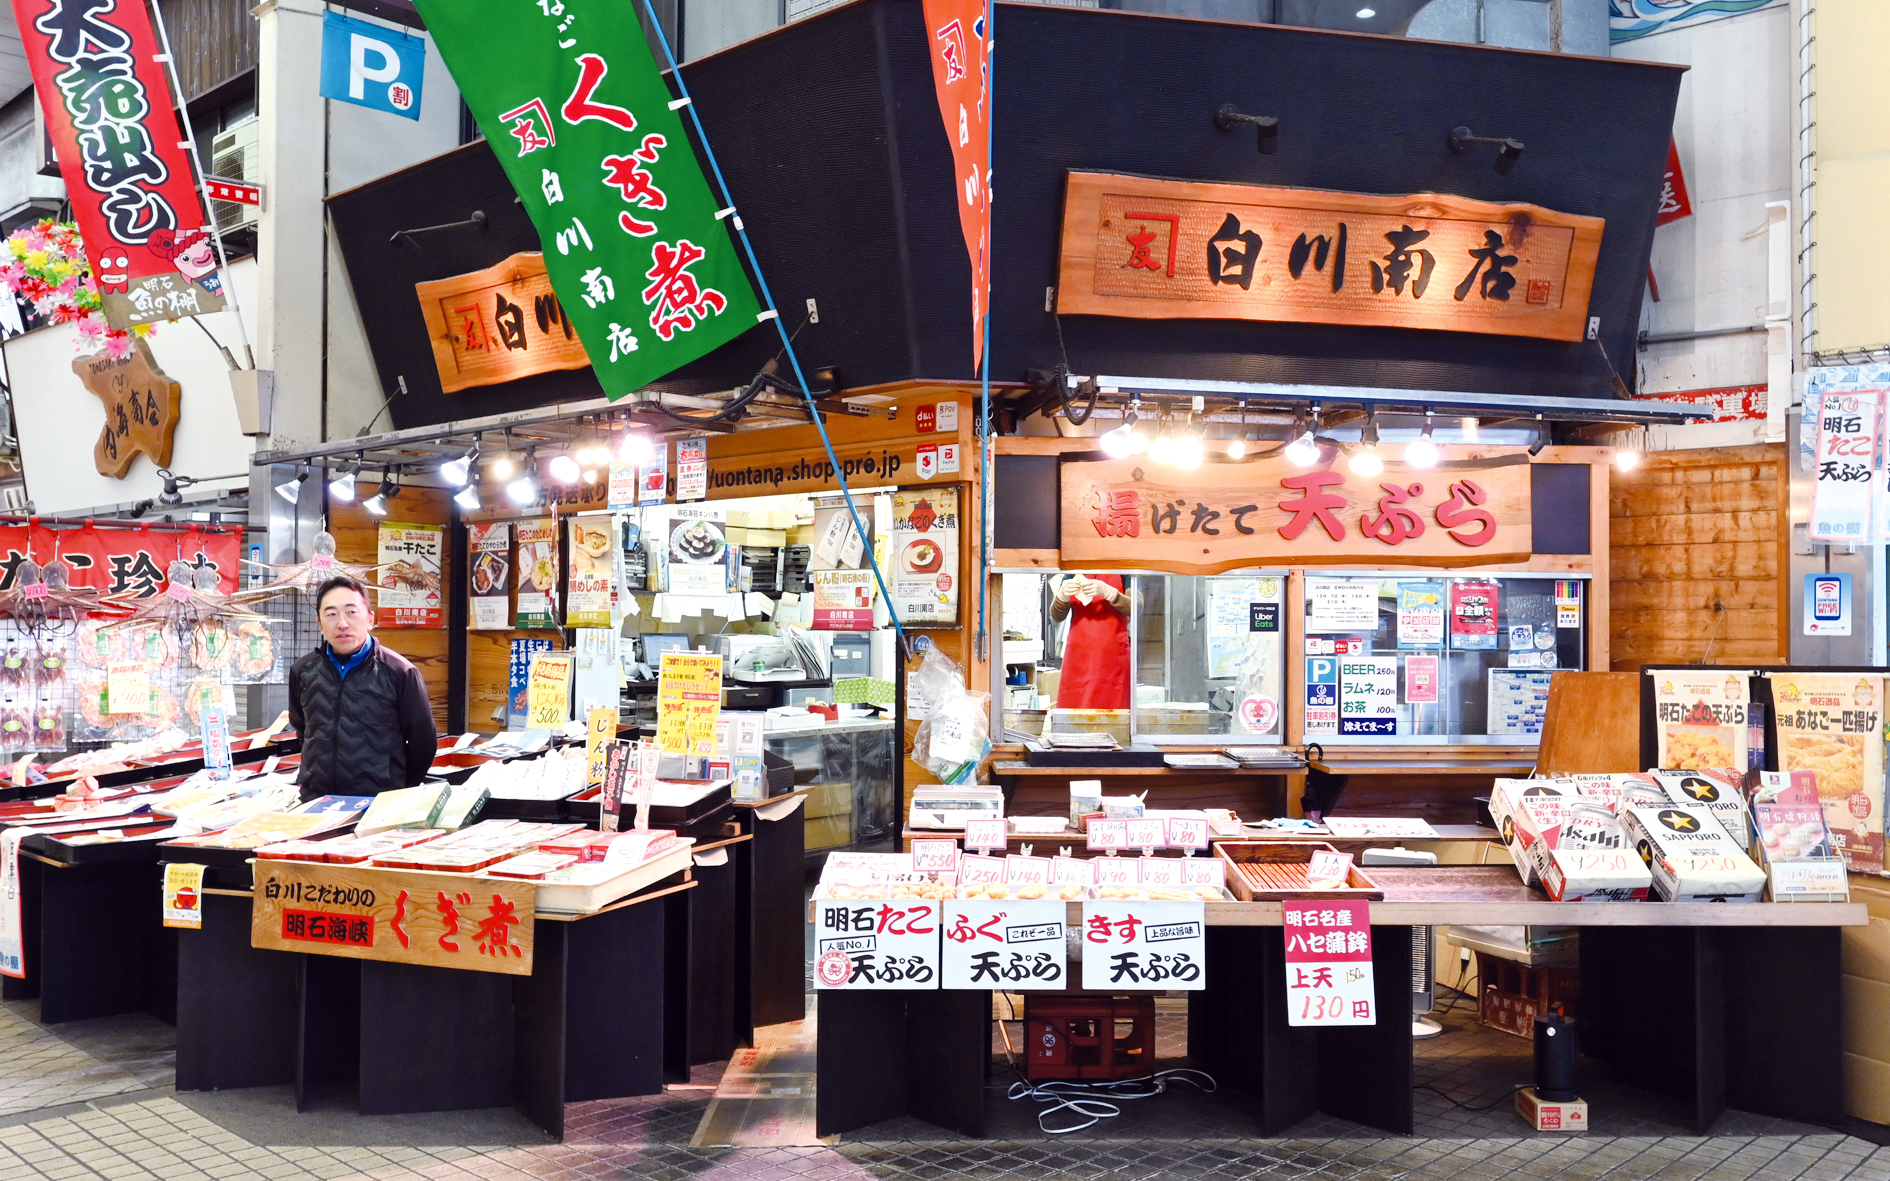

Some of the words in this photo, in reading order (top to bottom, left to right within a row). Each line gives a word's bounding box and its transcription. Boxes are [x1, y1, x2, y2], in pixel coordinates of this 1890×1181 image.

[349, 33, 400, 100] P
[392, 86, 409, 108] 割
[561, 53, 728, 341] くぎ煮
[541, 168, 640, 364] 白川南店
[1206, 213, 1518, 302] 白川南店
[142, 275, 174, 291] 明石
[127, 287, 201, 321] 魚の棚
[1823, 416, 1863, 434] 明石
[1827, 434, 1872, 456] たこ
[1818, 461, 1872, 483] 天ぷら
[1094, 490, 1258, 538] 揚げたて
[1277, 471, 1497, 547] 天ぷら
[403, 542, 437, 555] 干たこ
[569, 579, 609, 593] 鯛めしの素
[815, 572, 840, 585] じん粉
[908, 603, 935, 614] 白川南店
[1254, 612, 1274, 621] Uber
[1255, 620, 1274, 628] Eats
[1312, 659, 1332, 683] P
[1343, 664, 1376, 675] BEER
[1343, 682, 1375, 694] ラムネ
[1309, 697, 1335, 705] 魚の棚
[1343, 700, 1367, 713] お茶
[1306, 711, 1337, 720] 駐車割引券
[1659, 703, 1745, 725] 明石たこの天ぷら
[1777, 714, 1794, 727] 元祖
[1795, 709, 1879, 734] あなご一匹揚げ
[1760, 812, 1821, 822] 明石焼物語
[1560, 825, 1620, 848] Asahi
[1662, 833, 1722, 842] SAPPORO
[265, 877, 376, 908] 白川こだわりの
[286, 914, 369, 944] 明石海峡
[390, 889, 523, 958] くぎ煮
[824, 903, 934, 936] 明石たこ
[946, 911, 1008, 944] ふぐ
[1086, 913, 1143, 945] きす
[1285, 909, 1353, 927] 明石名産
[1150, 925, 1195, 939] 上品な旨味
[1286, 930, 1369, 954] ハセ蒲鉾
[848, 954, 934, 985] 天ぷら
[970, 951, 1062, 984] 天ぷら
[1109, 952, 1201, 984] 天ぷら
[1290, 967, 1334, 989] 上天
